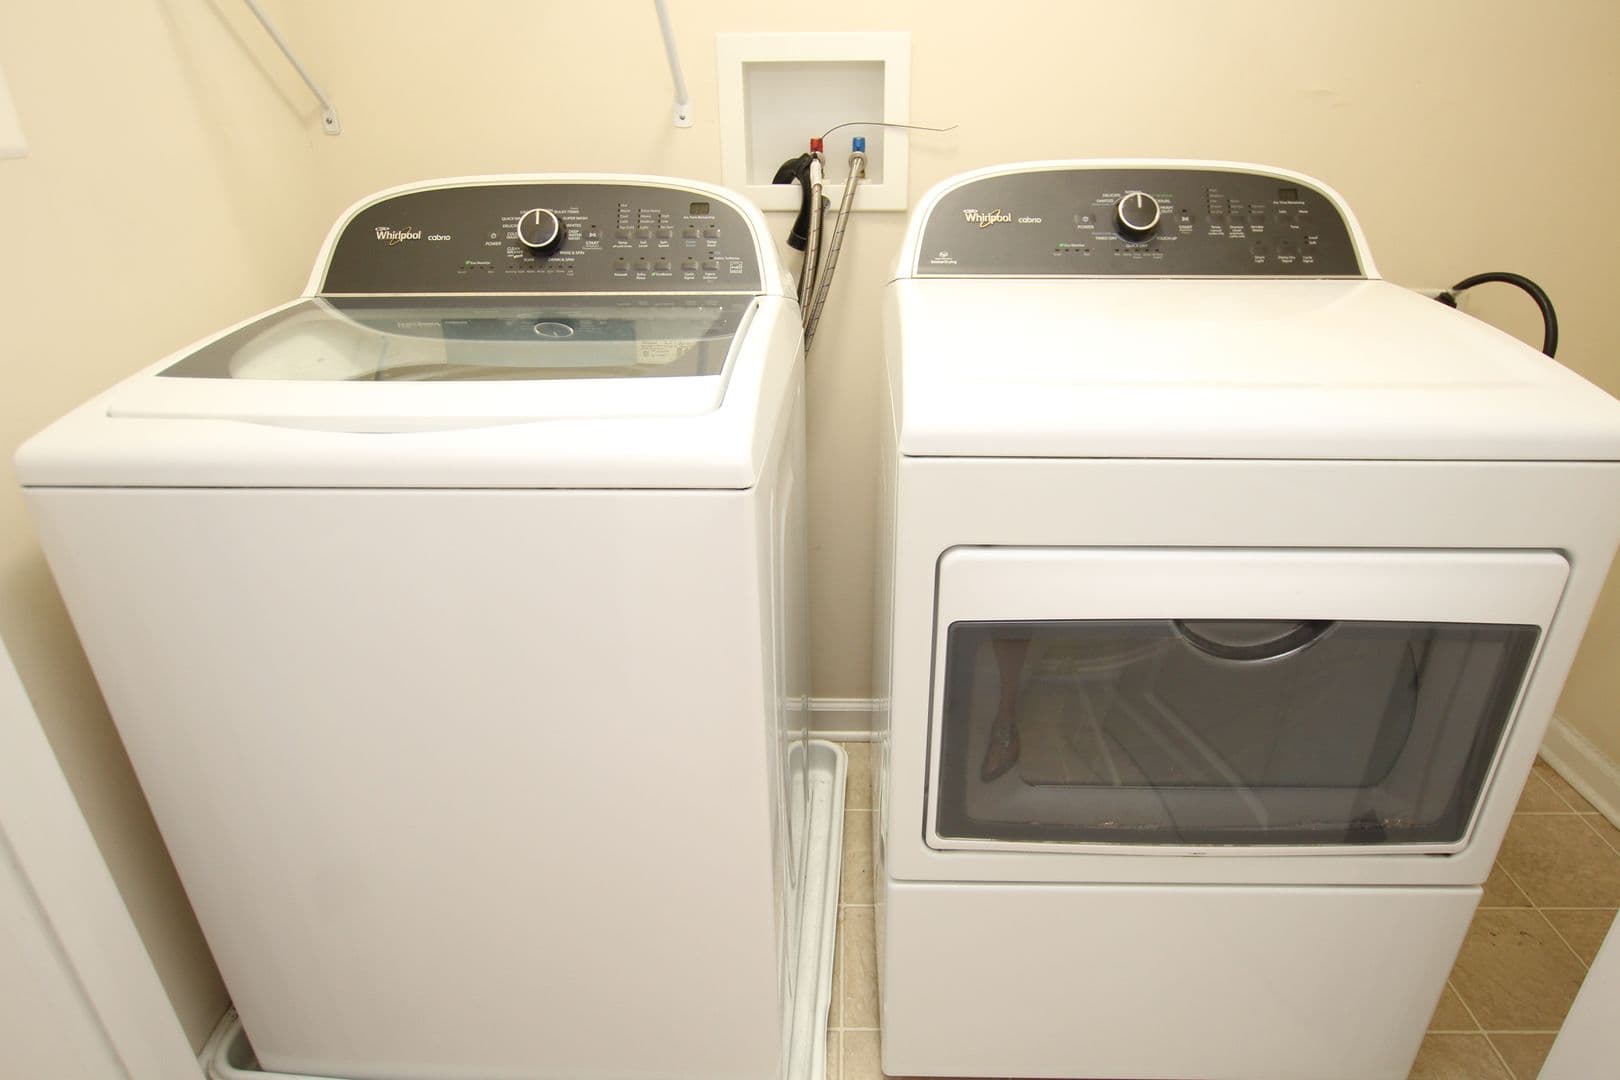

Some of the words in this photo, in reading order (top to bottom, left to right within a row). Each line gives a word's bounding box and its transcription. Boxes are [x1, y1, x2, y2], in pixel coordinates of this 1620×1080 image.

[964, 212, 1011, 225] Whirlpool
[376, 229, 422, 243] Whirlpool
[427, 233, 452, 241] cabrio
